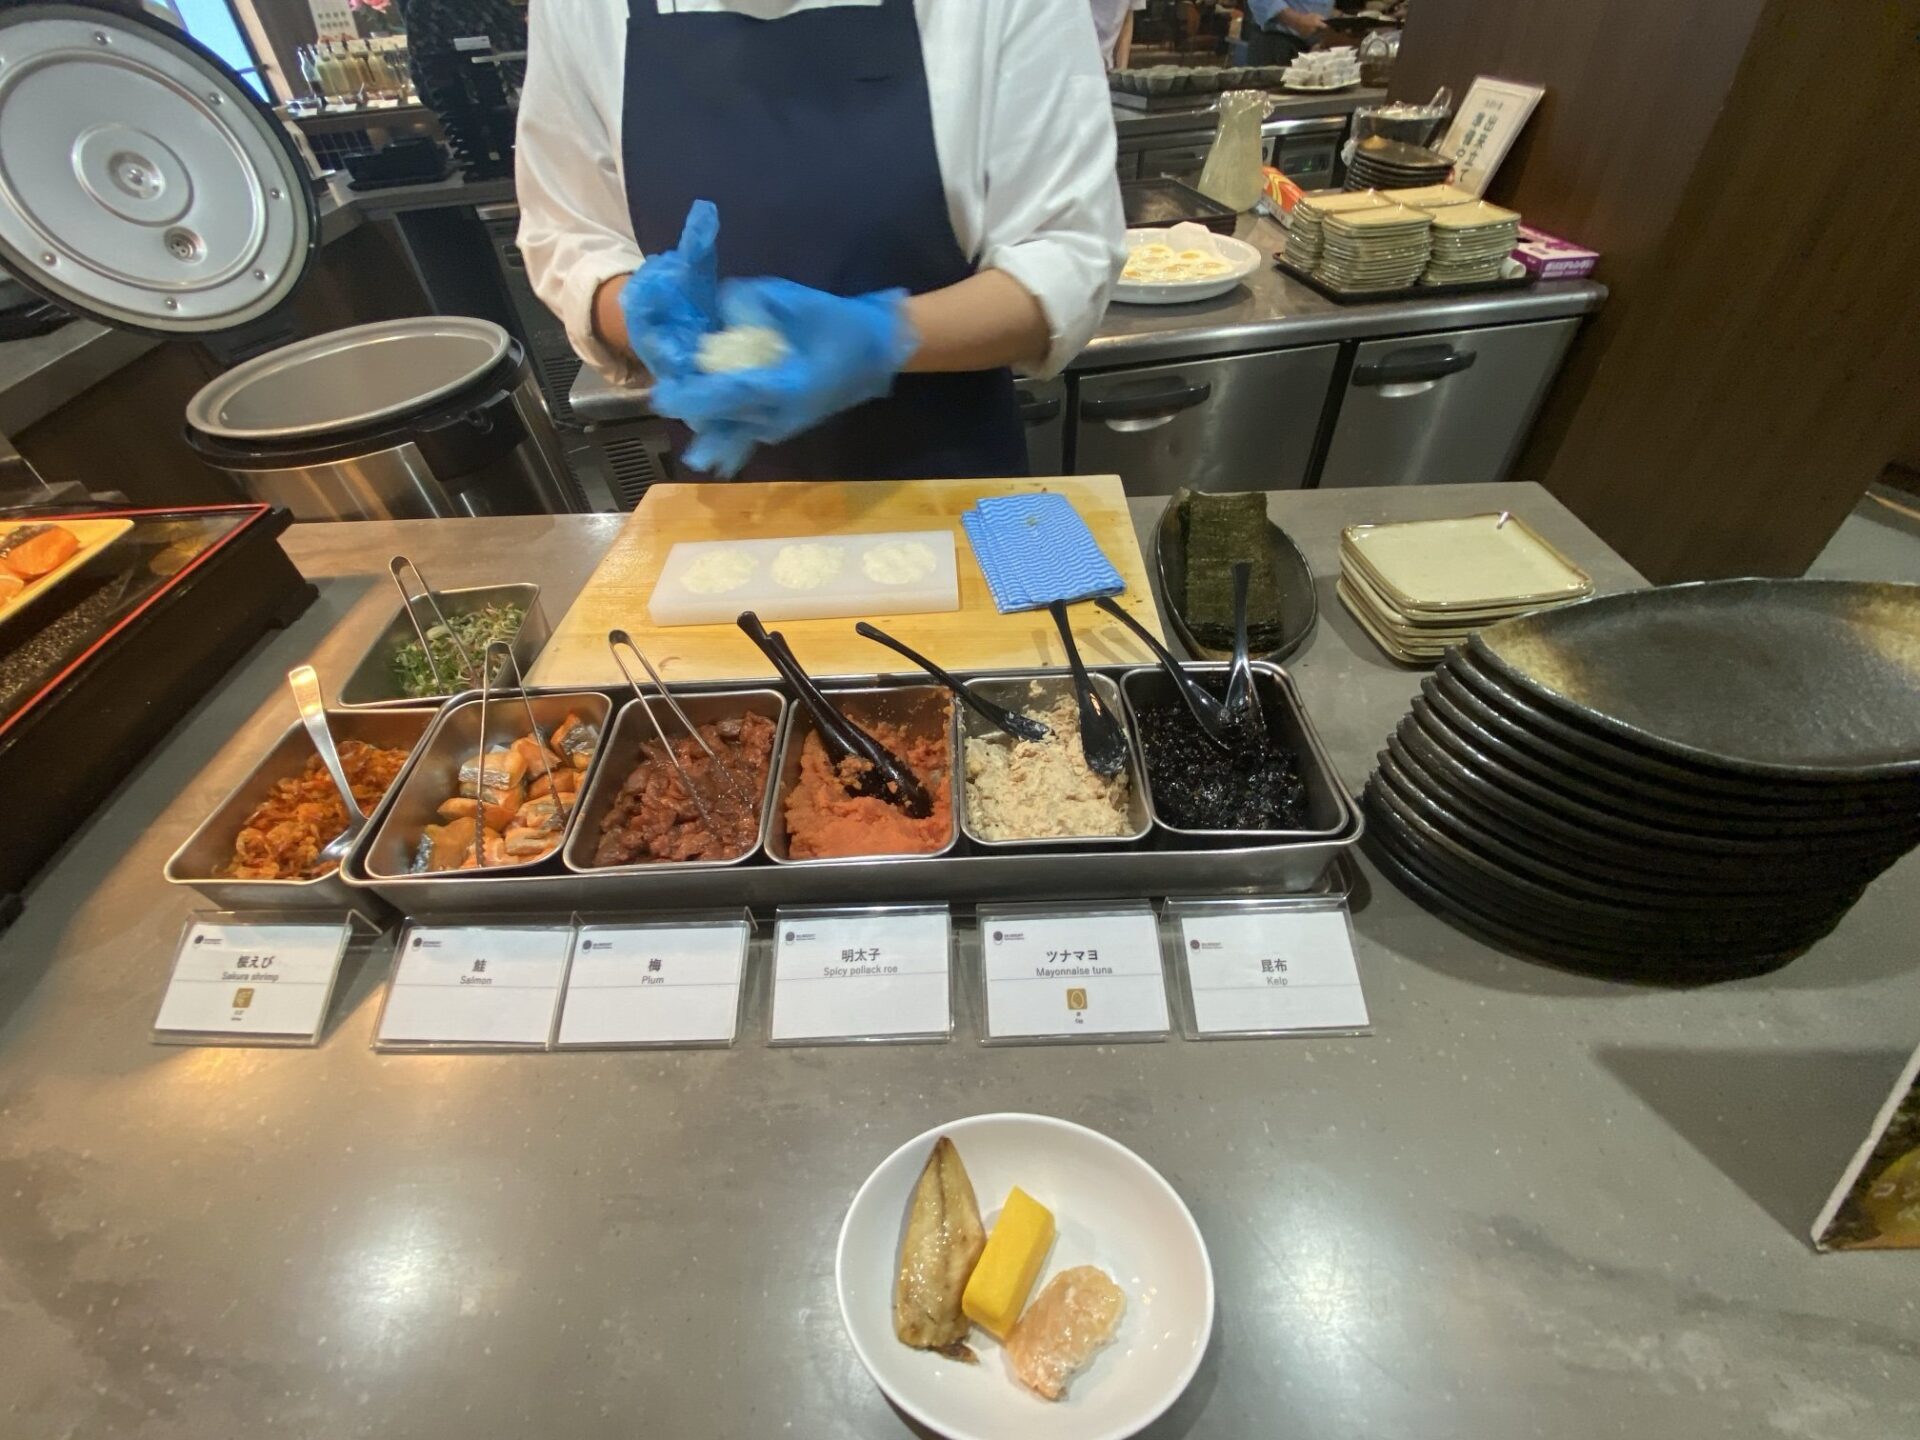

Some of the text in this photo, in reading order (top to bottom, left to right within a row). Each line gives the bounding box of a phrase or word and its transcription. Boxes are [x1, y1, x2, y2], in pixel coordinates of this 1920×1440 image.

[841, 947, 881, 962] 明太子
[1046, 949, 1099, 963] ツナマヨ
[471, 958, 488, 972] 鮭
[648, 958, 662, 972] 梅
[824, 966, 848, 977] Spicy
[883, 965, 898, 973] roe
[1261, 958, 1288, 973] 昆布
[1036, 966, 1113, 978] Mayonnaise tuna
[459, 975, 493, 985] Salmon
[641, 976, 665, 985] Plum
[1266, 976, 1288, 986] Kelp
